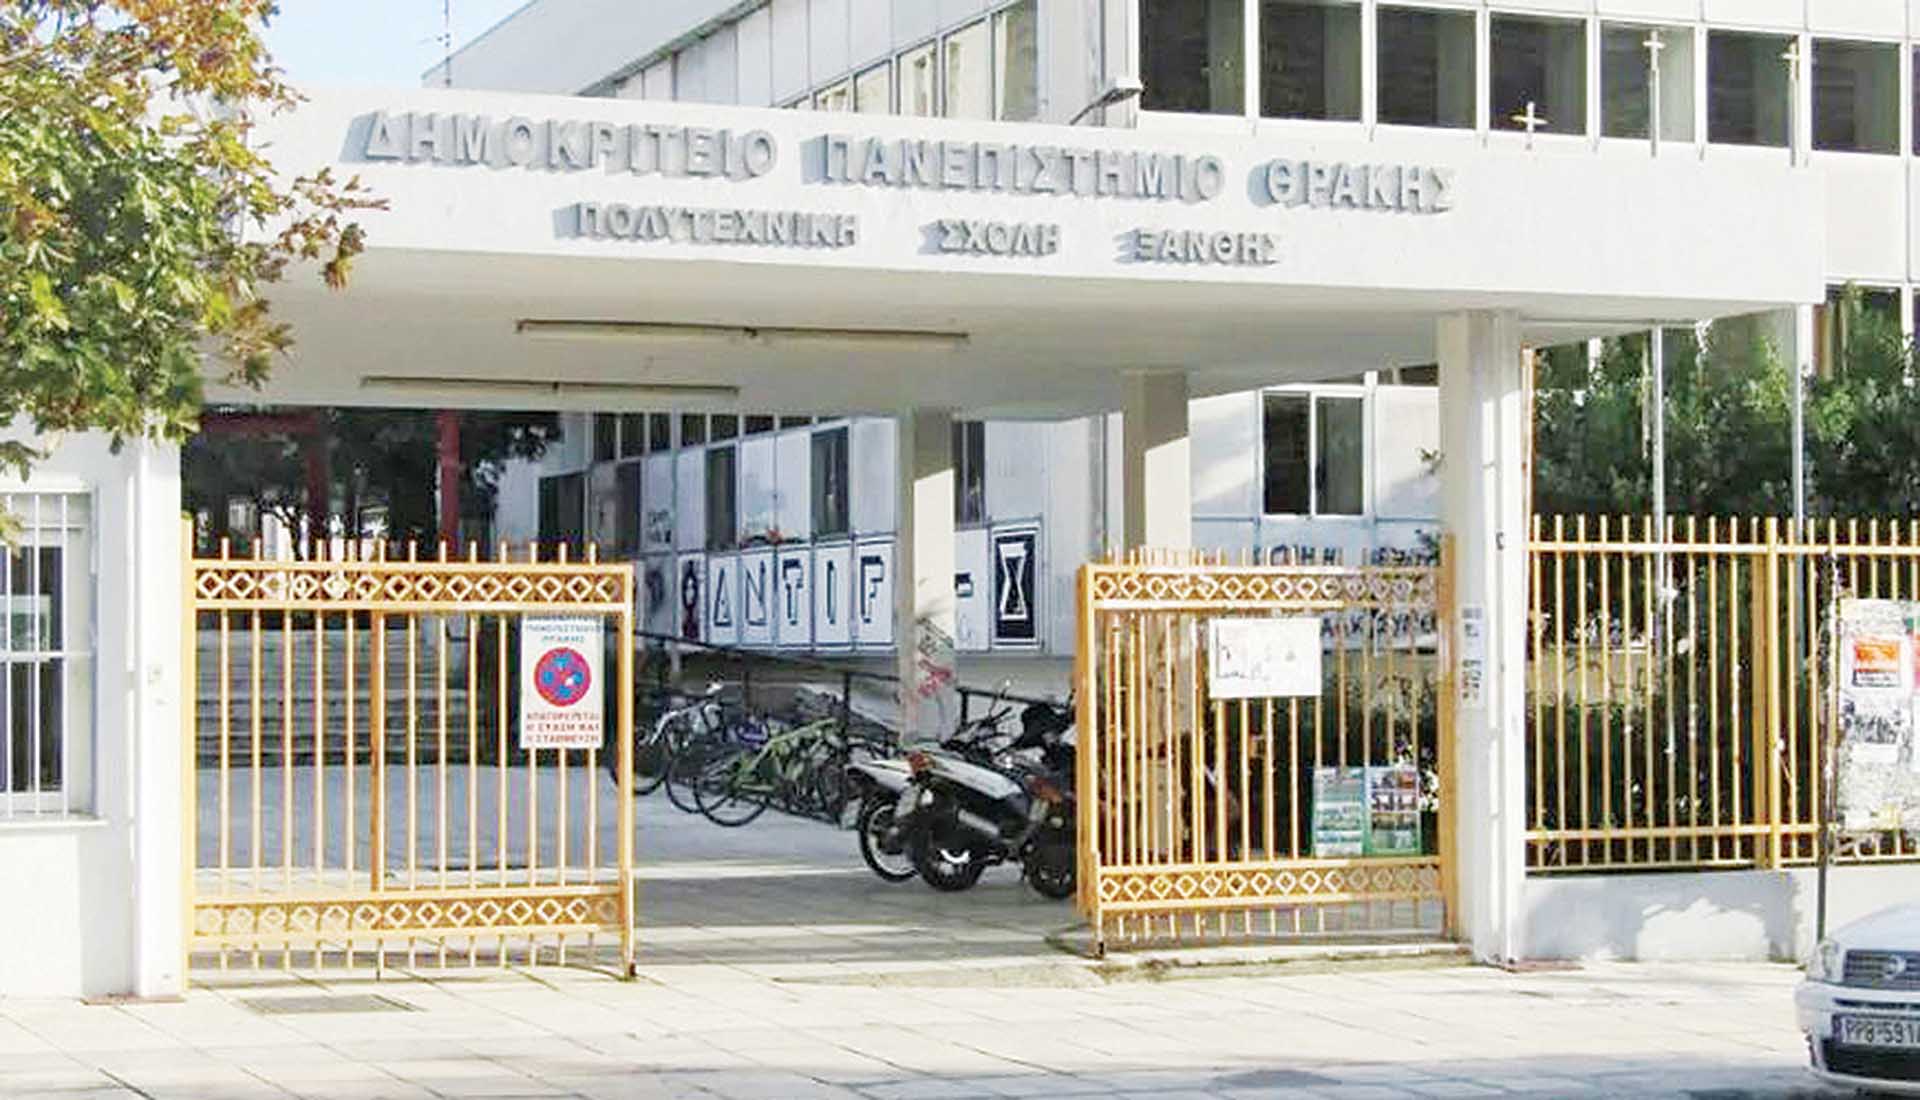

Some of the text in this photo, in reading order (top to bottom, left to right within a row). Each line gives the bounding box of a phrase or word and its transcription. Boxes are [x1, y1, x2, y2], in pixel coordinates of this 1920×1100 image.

[364, 111, 1456, 214] ΔΗΜΟΚΡΙΤΕΙΟ ΠΑΝΕΠΙΣΤΗΜΙΟ ΘΡΑΚΗΣ
[576, 201, 1282, 266] ΠΟΛΥΤΕΧΝΙΚΗ ΣΧΟΛΗ ΞΑΝΘΗΣ
